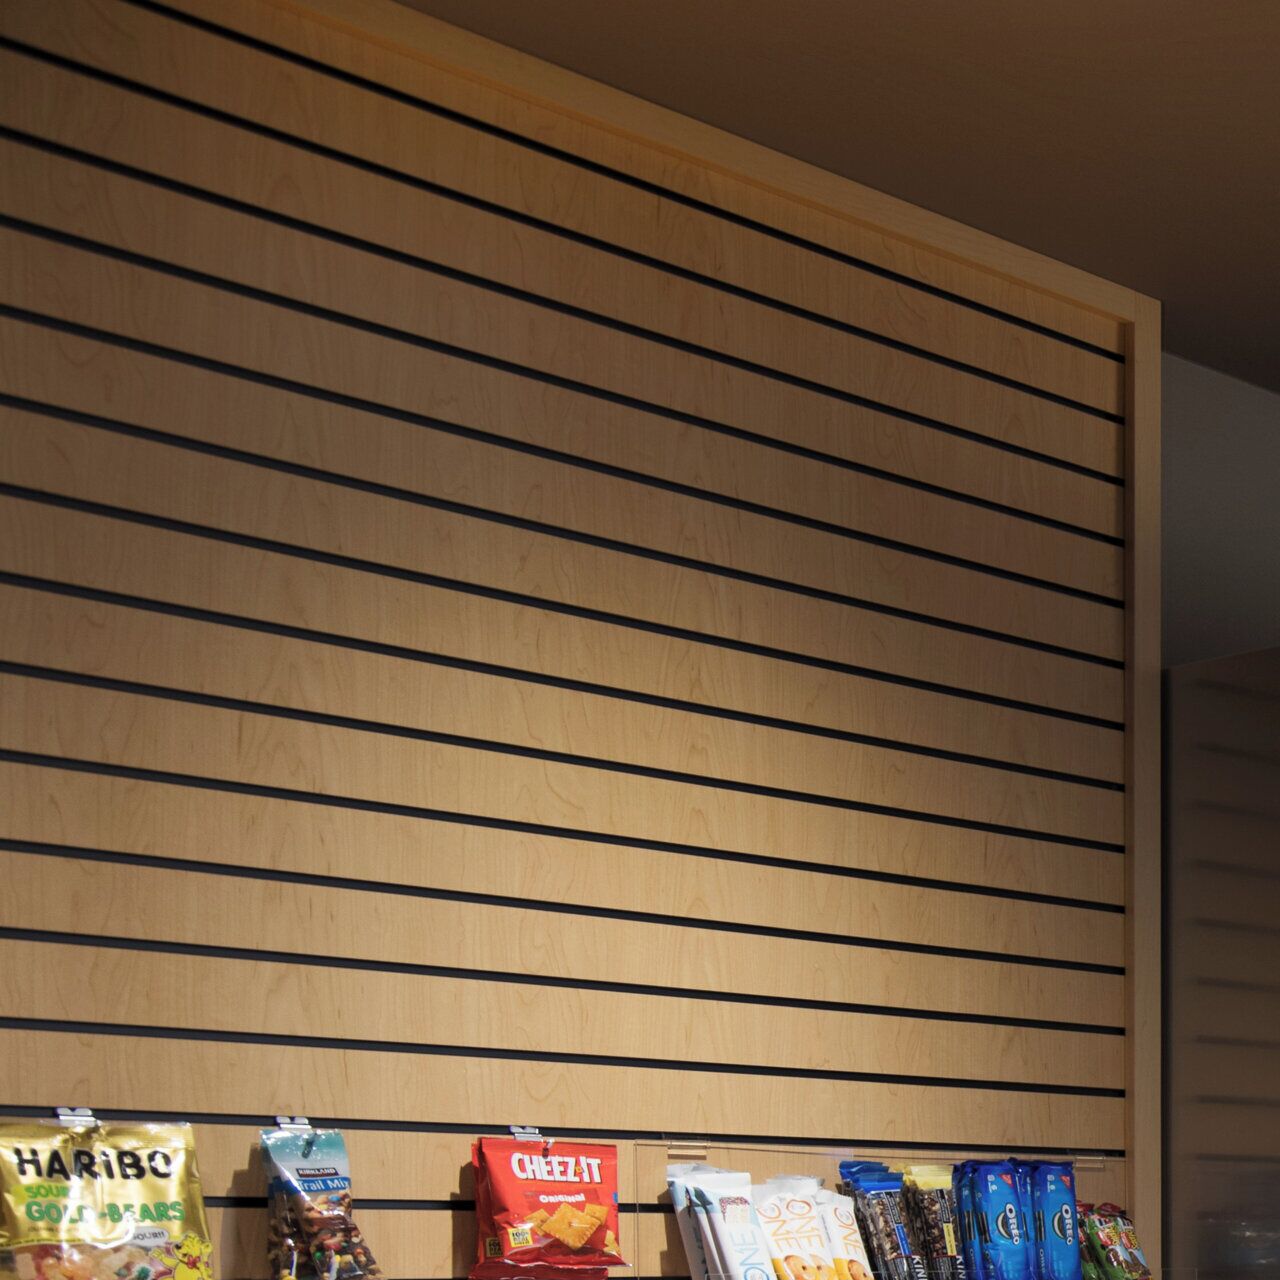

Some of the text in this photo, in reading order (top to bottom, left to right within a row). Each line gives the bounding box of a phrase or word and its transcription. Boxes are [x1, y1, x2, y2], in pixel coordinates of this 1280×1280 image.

[13, 1147, 173, 1181] HARIBO
[298, 1178, 351, 1191] Trail Mix
[785, 1198, 825, 1250] ONE
[1005, 1203, 1021, 1245] OREO
[1061, 1203, 1075, 1246] OREO
